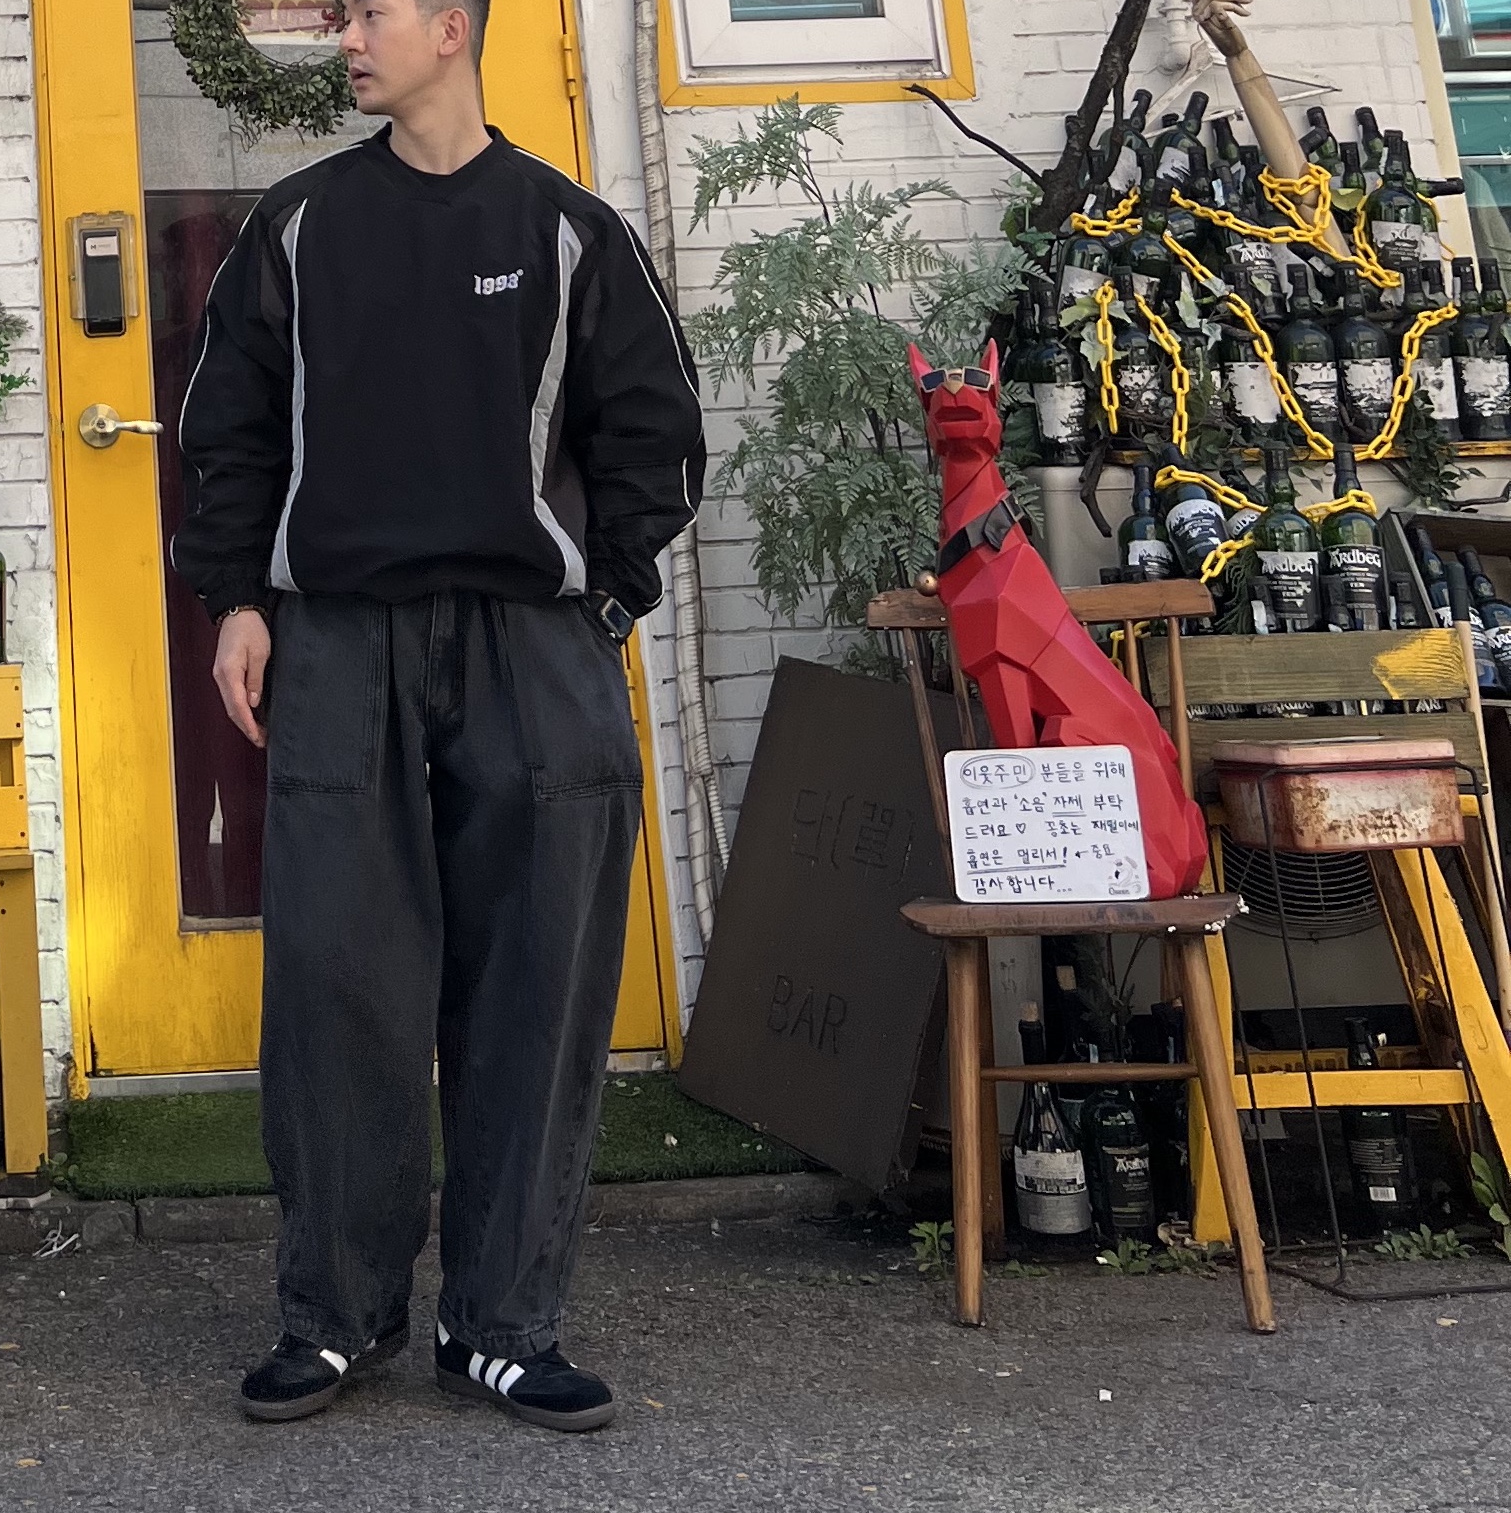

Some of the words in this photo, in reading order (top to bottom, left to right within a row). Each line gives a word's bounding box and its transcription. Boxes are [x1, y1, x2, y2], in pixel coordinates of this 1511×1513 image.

[963, 764, 1029, 785] 이웃주민
[1040, 762, 1087, 783] 분들을
[1092, 761, 1126, 780] 위해
[1053, 795, 1083, 810] 자제
[1093, 794, 1124, 811] 부탁
[1091, 844, 1116, 859] 중요
[768, 974, 849, 1055] BAR
